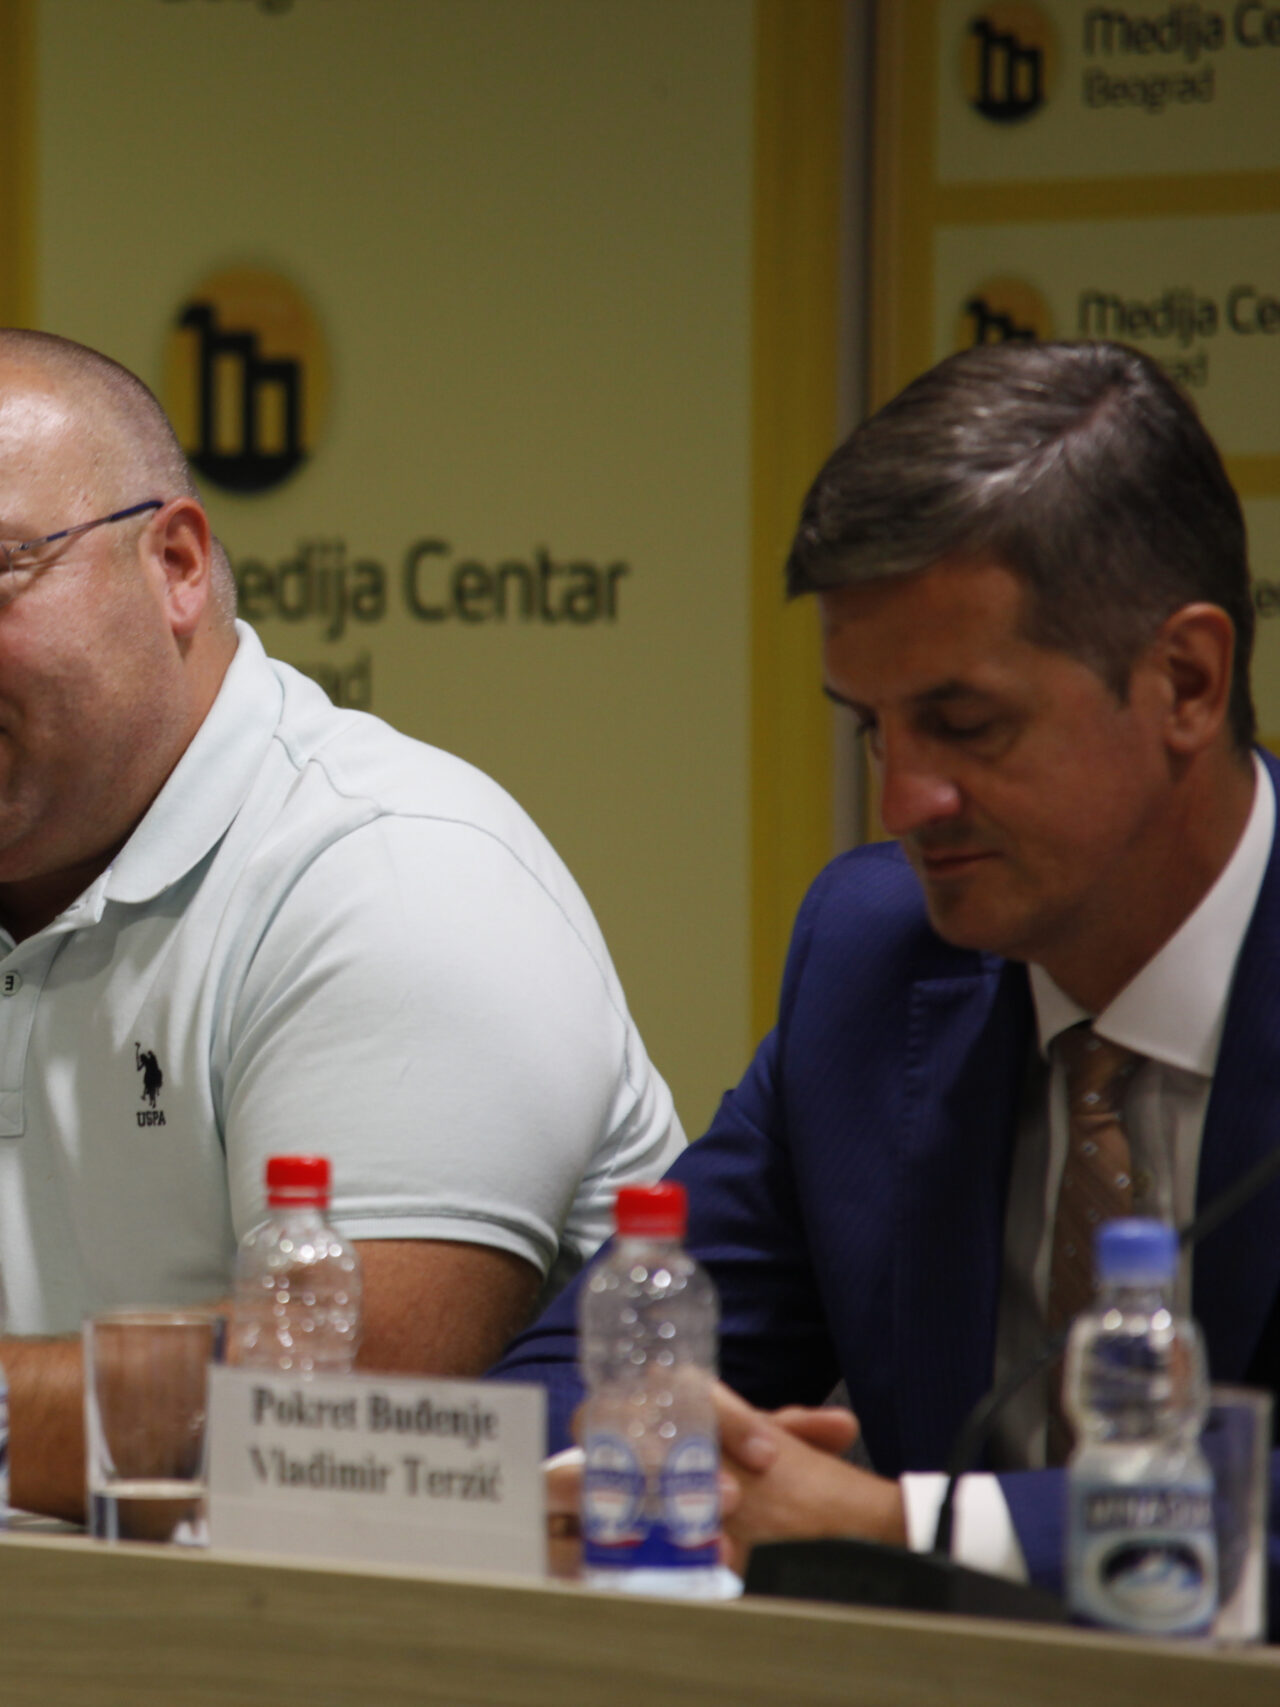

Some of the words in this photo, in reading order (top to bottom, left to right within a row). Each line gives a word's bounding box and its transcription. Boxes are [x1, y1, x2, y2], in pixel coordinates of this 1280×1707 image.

[1081, 4, 1225, 63] Medija
[1081, 63, 1216, 114] Beograd
[1077, 286, 1220, 347] Medija
[232, 534, 389, 644] edija
[401, 534, 629, 626] Centar
[136, 1111, 166, 1127] USPA
[251, 1386, 358, 1431] Pokret
[247, 1446, 393, 1495] Vladimir
[402, 1456, 502, 1504] Terzić
